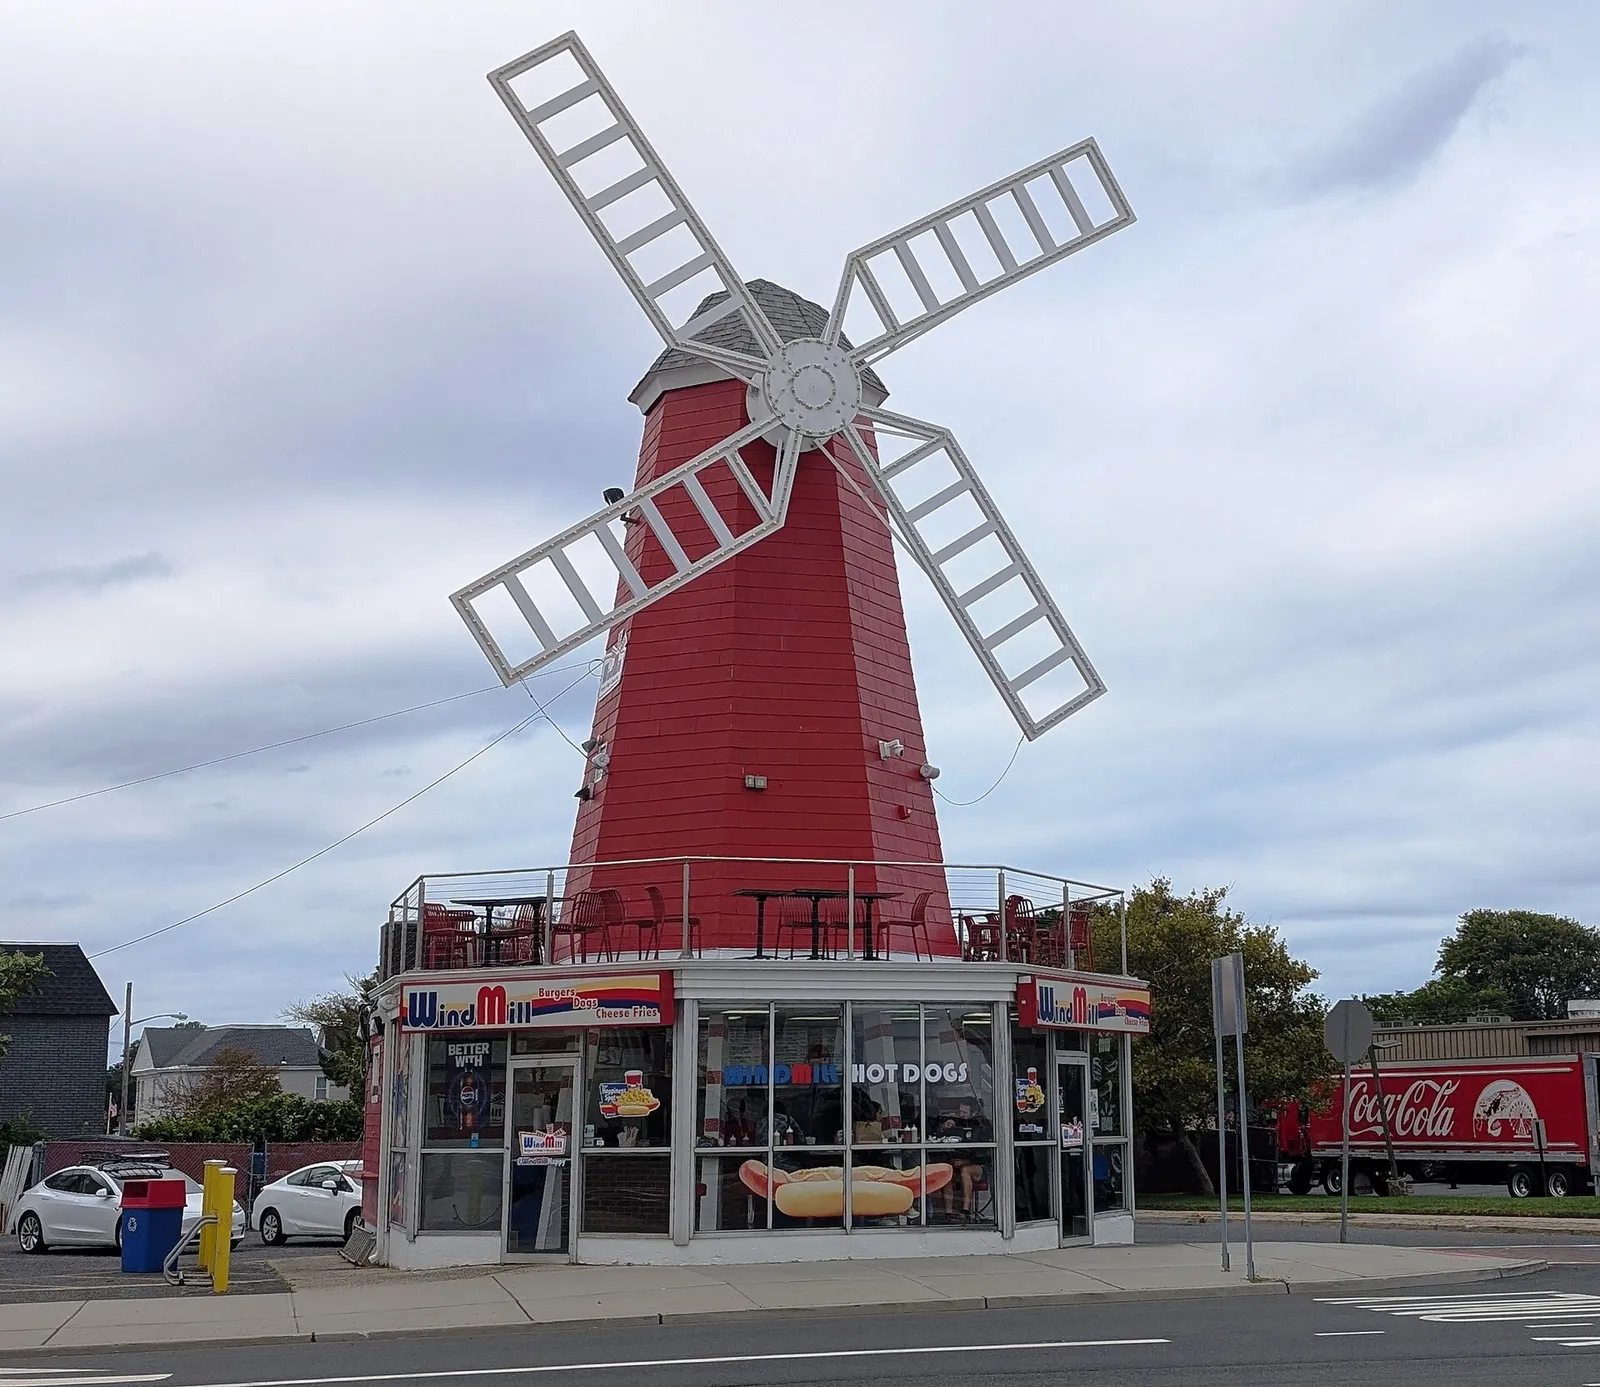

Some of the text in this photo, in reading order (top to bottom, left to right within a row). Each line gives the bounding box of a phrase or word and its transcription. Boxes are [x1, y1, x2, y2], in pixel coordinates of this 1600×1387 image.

[538, 987, 575, 999] Burgers
[408, 985, 531, 1028] WindMill
[574, 998, 597, 1009] Dogs
[1039, 986, 1098, 1025] WindMill
[596, 1006, 657, 1018] Cheese Fries
[448, 1042, 490, 1056] BETTER
[455, 1054, 483, 1068] WITH
[851, 1063, 898, 1083] HOT
[903, 1062, 968, 1083] DOGS
[1342, 1079, 1460, 1137] Coca-Cola
[523, 1136, 563, 1149] WindMill
